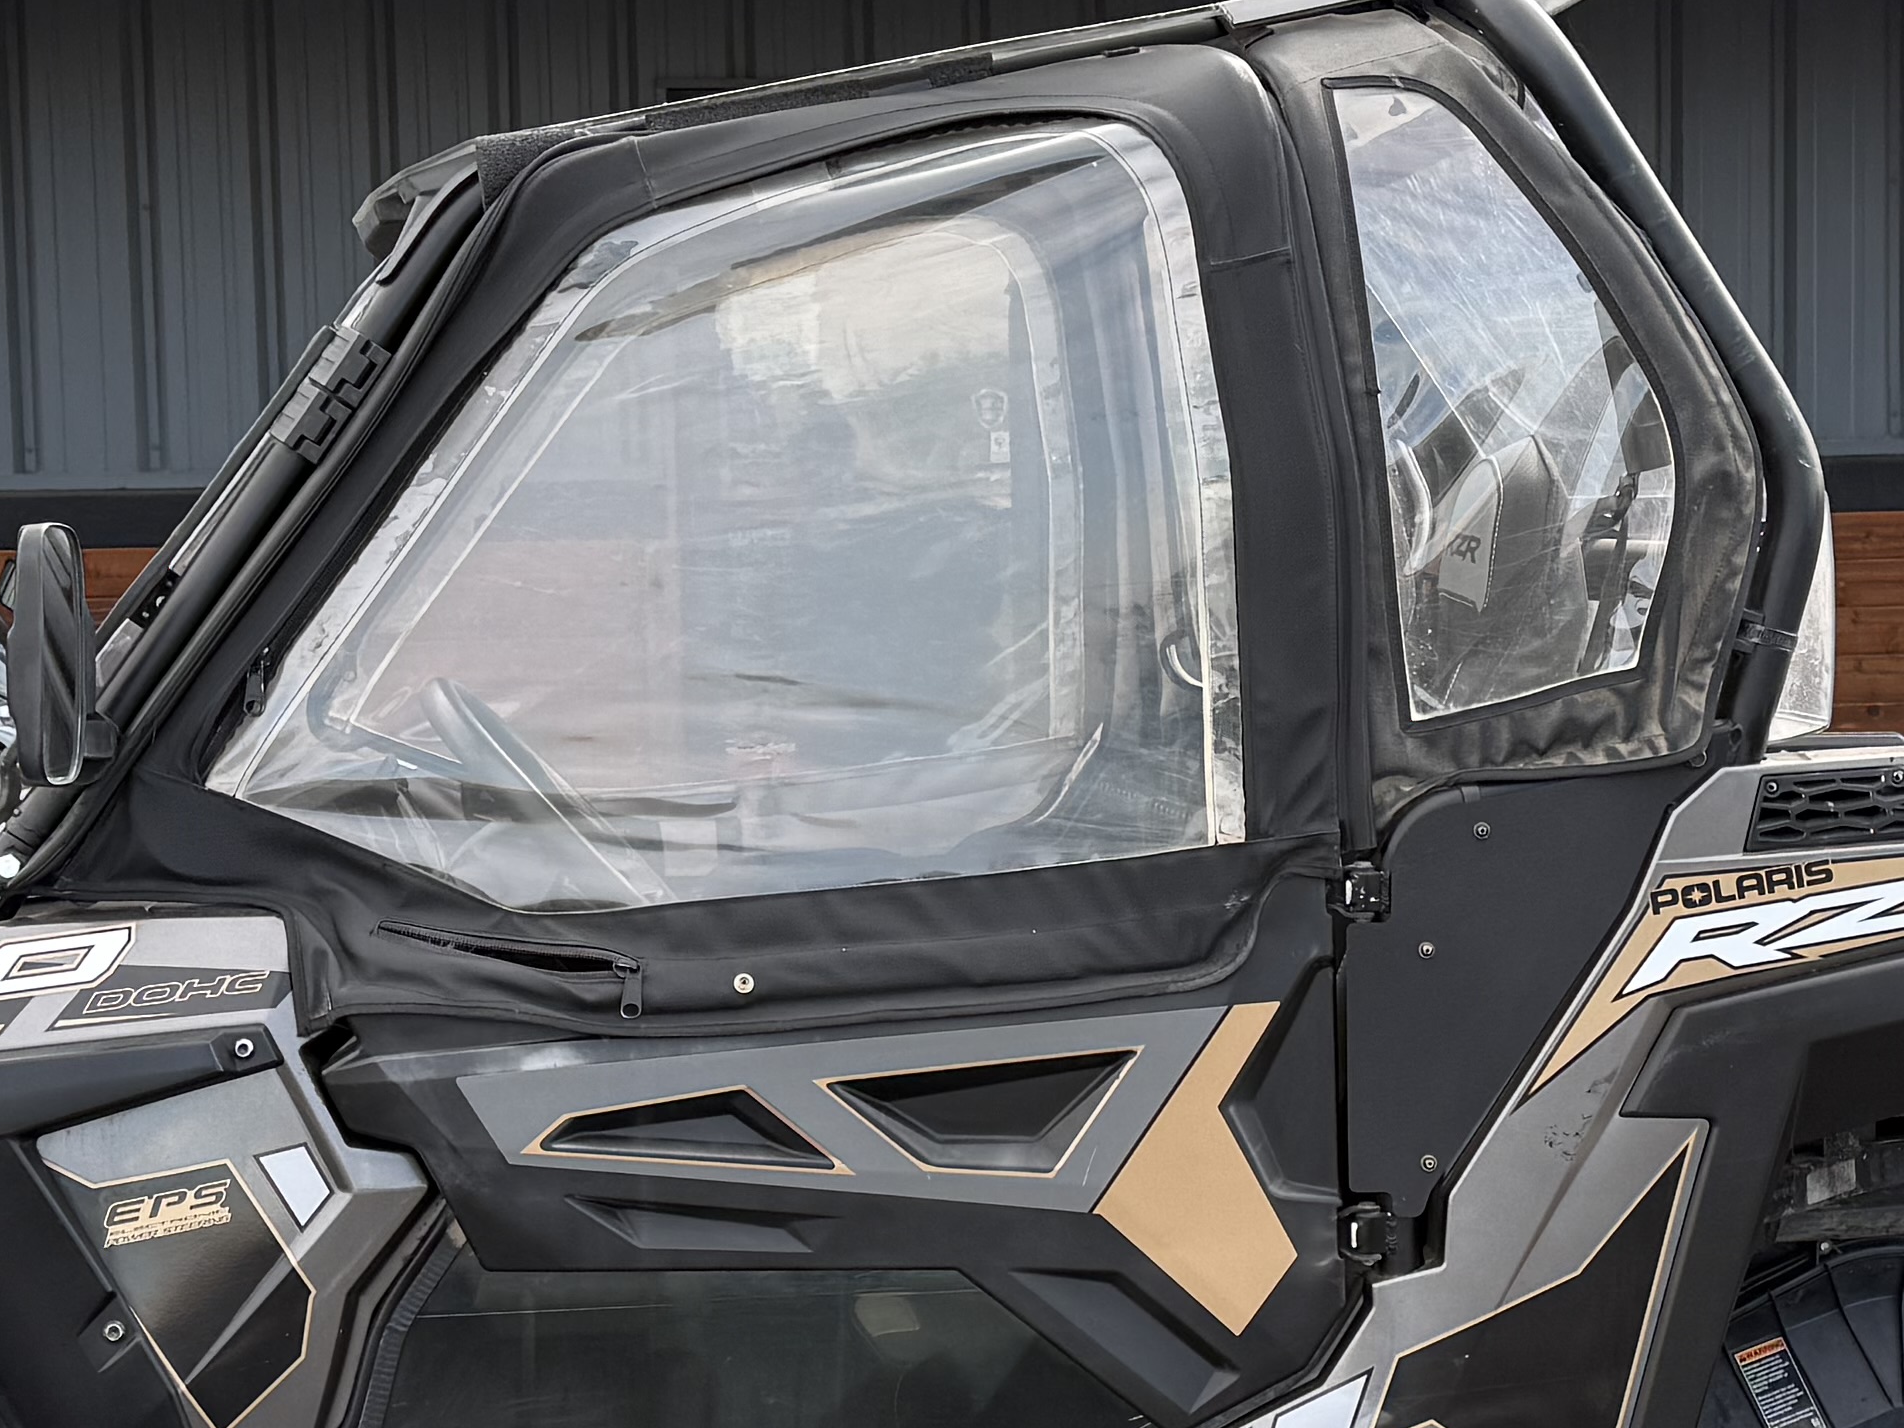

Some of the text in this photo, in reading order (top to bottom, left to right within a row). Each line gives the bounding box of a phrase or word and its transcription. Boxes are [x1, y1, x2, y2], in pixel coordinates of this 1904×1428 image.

[1442, 532, 1482, 564] ZR
[1652, 859, 1834, 915] POLARIS
[82, 970, 268, 1014] DOHC
[107, 1180, 229, 1227] EPS
